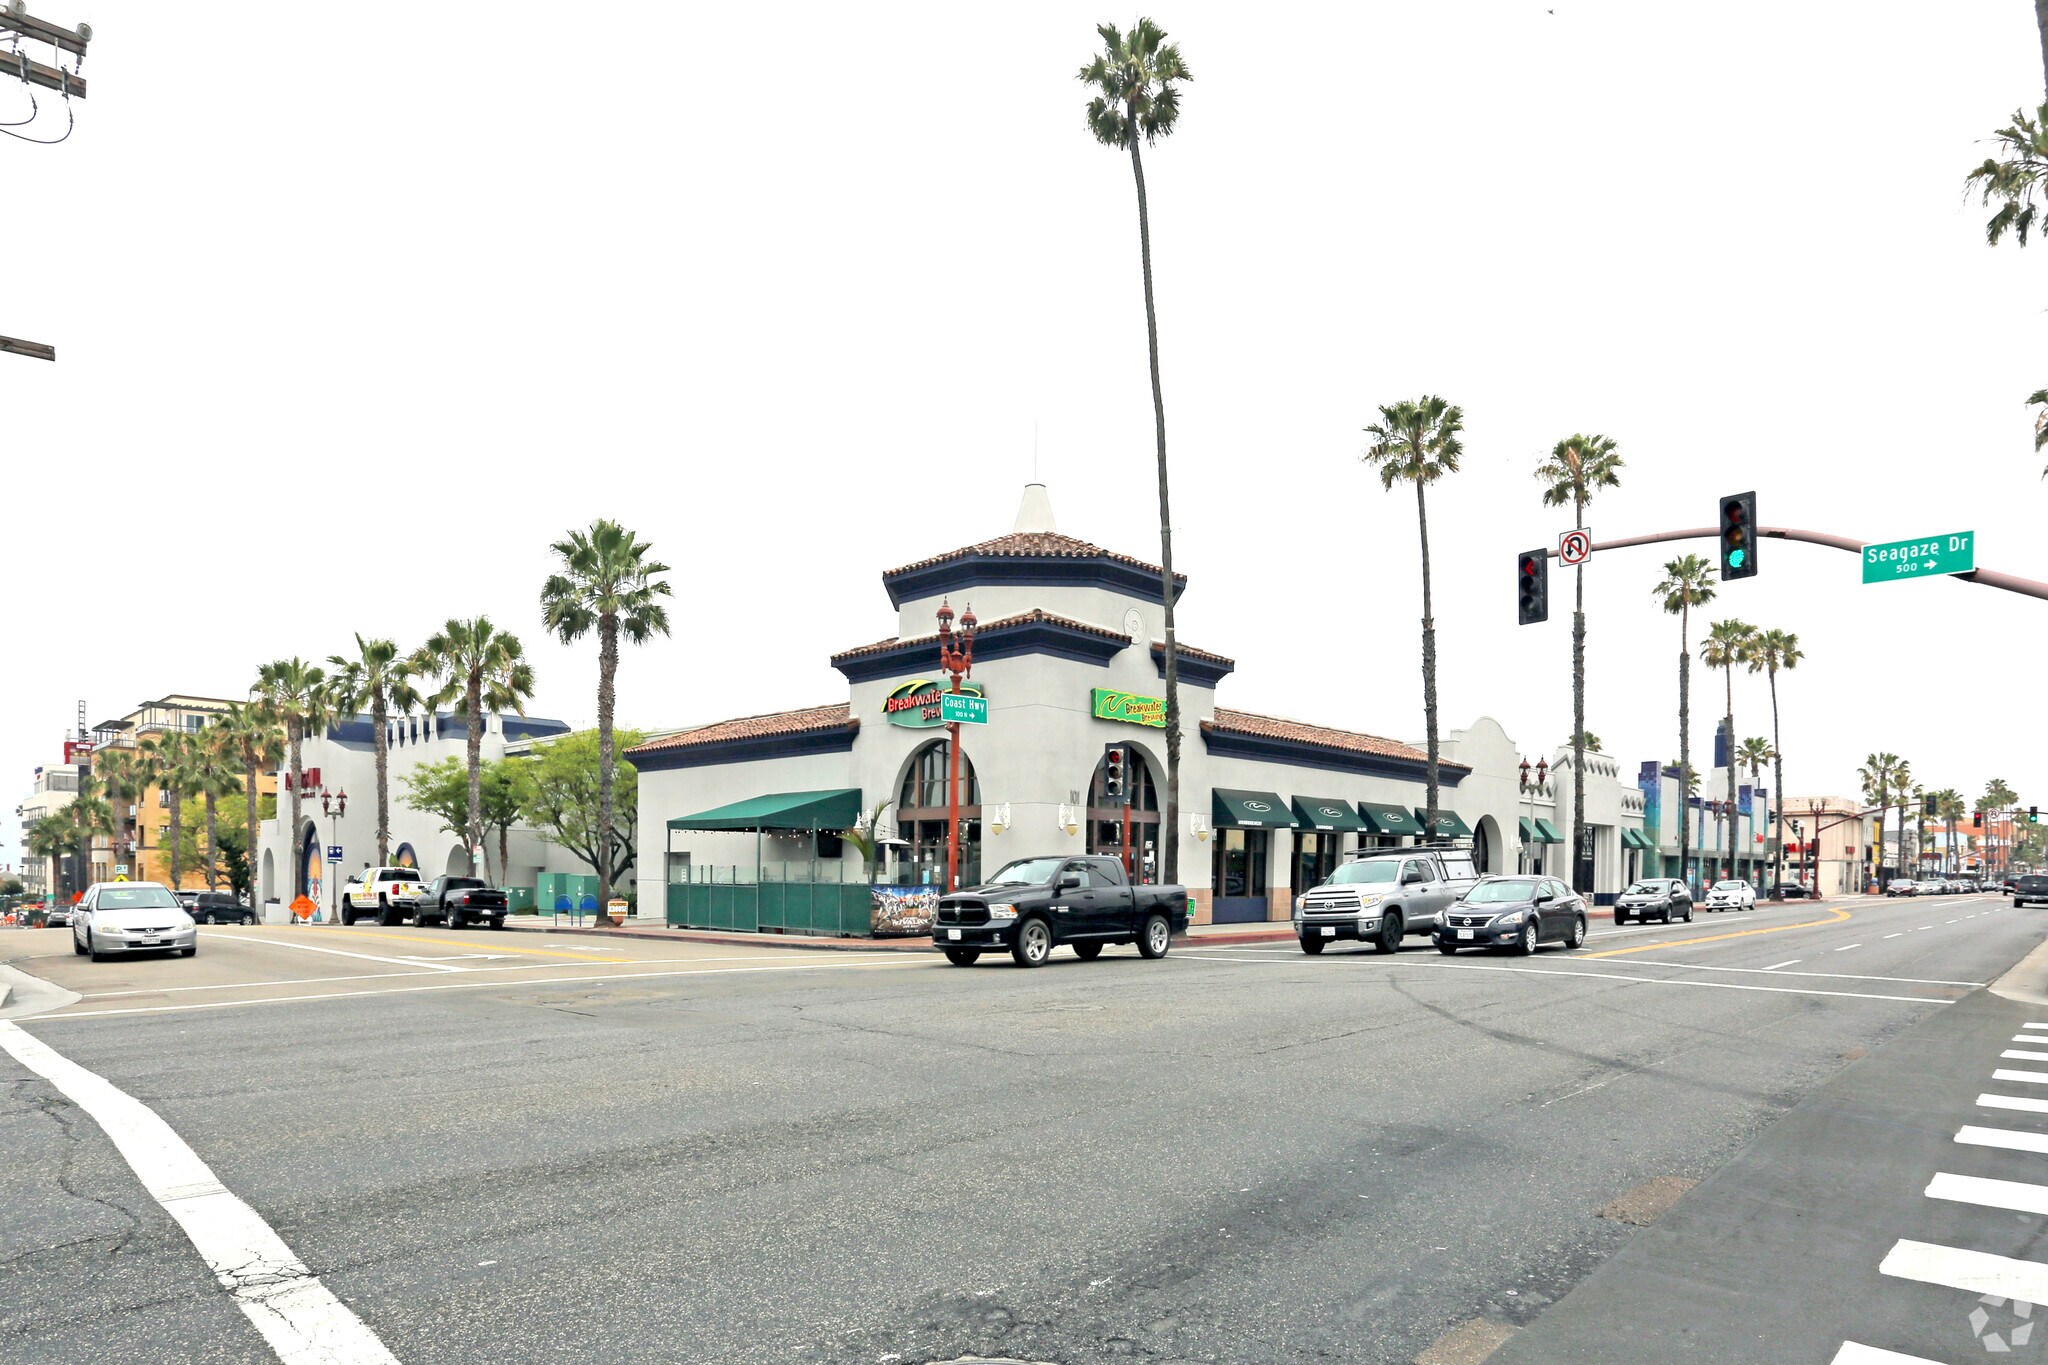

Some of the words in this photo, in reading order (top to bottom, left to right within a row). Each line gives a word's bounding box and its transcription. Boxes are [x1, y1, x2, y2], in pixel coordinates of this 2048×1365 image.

[1867, 542, 1939, 564] Seagaze
[1949, 536, 1969, 552] Dr
[1896, 562, 1917, 573] 500
[944, 696, 966, 709] Coast
[969, 700, 985, 713] Hwy
[1125, 700, 1162, 714] Breakwater
[1069, 789, 1080, 804] 101
